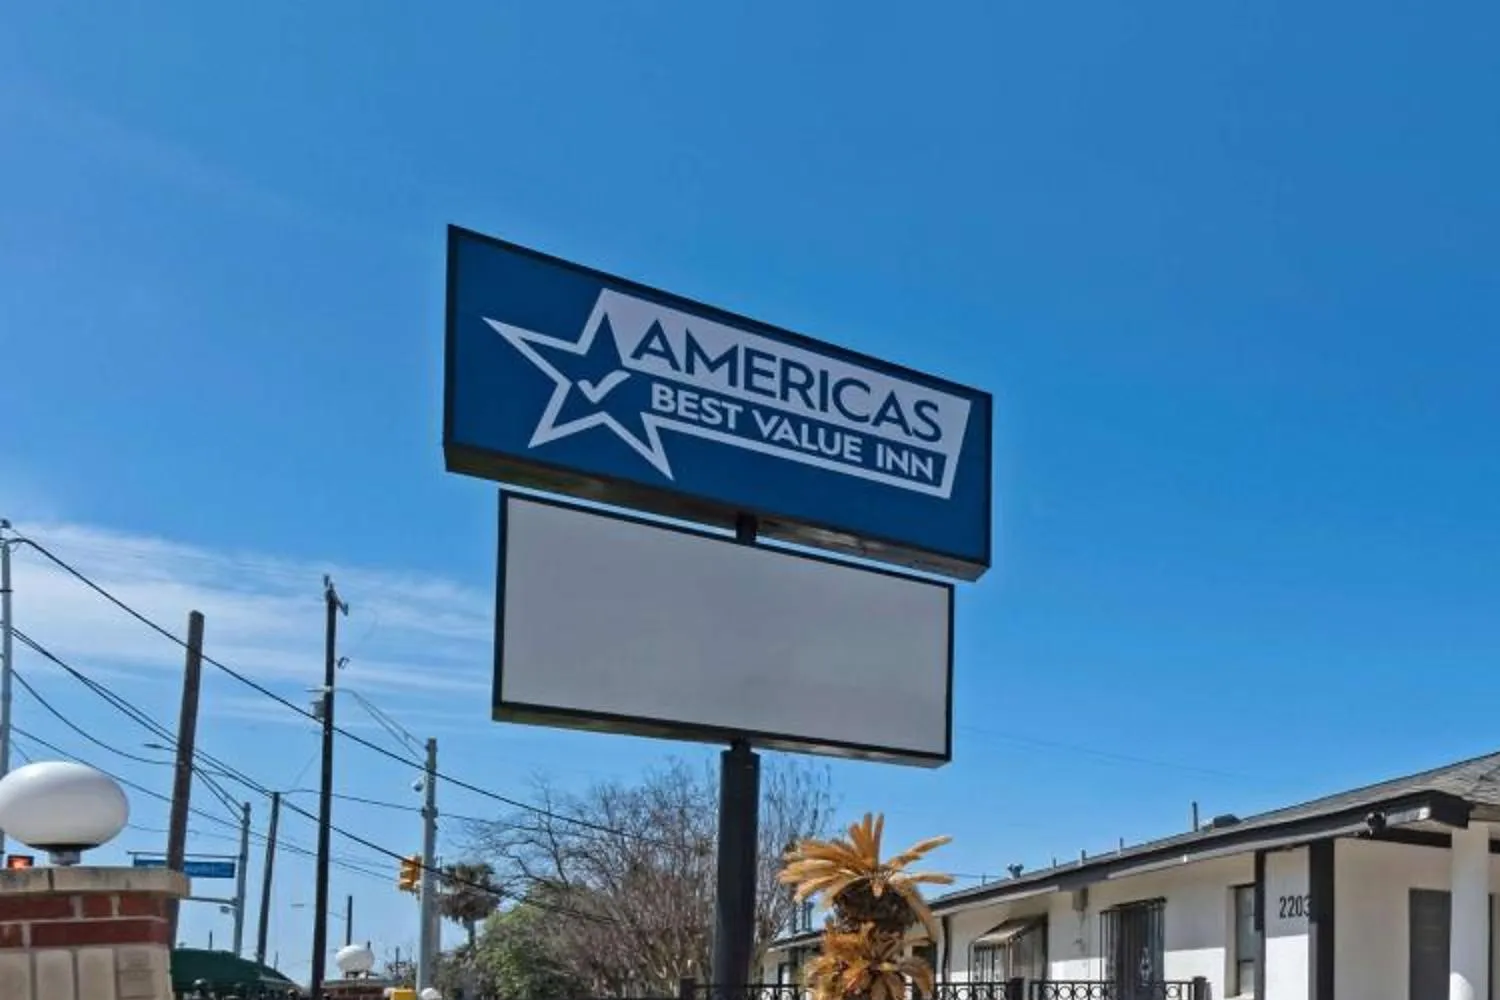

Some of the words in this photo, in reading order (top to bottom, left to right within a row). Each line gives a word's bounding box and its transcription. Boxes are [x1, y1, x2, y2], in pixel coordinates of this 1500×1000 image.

[630, 319, 942, 442] AMERICAS
[651, 382, 743, 430] BEST
[752, 409, 863, 463] VALUE
[876, 443, 933, 481] INN
[1279, 895, 1312, 919] 2203
